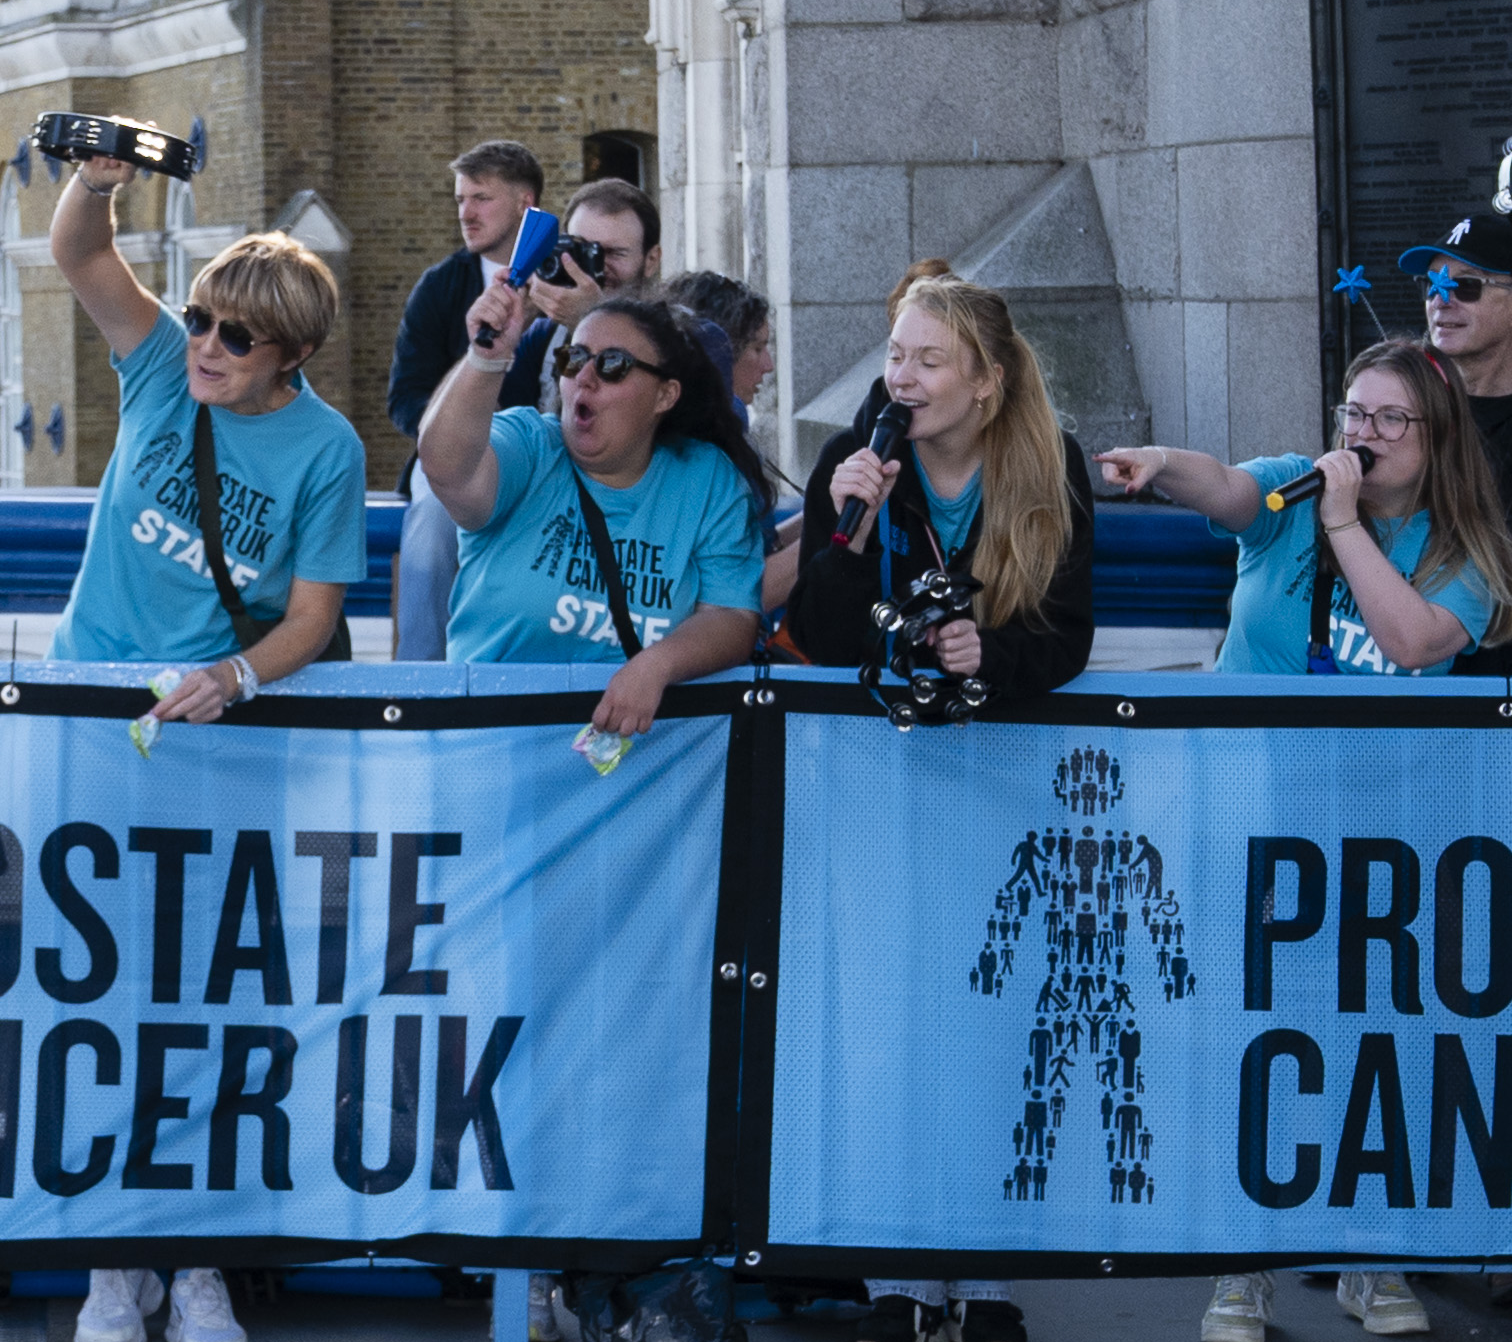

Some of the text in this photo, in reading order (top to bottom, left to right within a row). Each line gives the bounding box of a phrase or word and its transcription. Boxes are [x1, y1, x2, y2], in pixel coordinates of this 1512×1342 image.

[237, 525, 274, 563] UK
[641, 576, 674, 610] UK
[333, 1013, 525, 1193] UK
